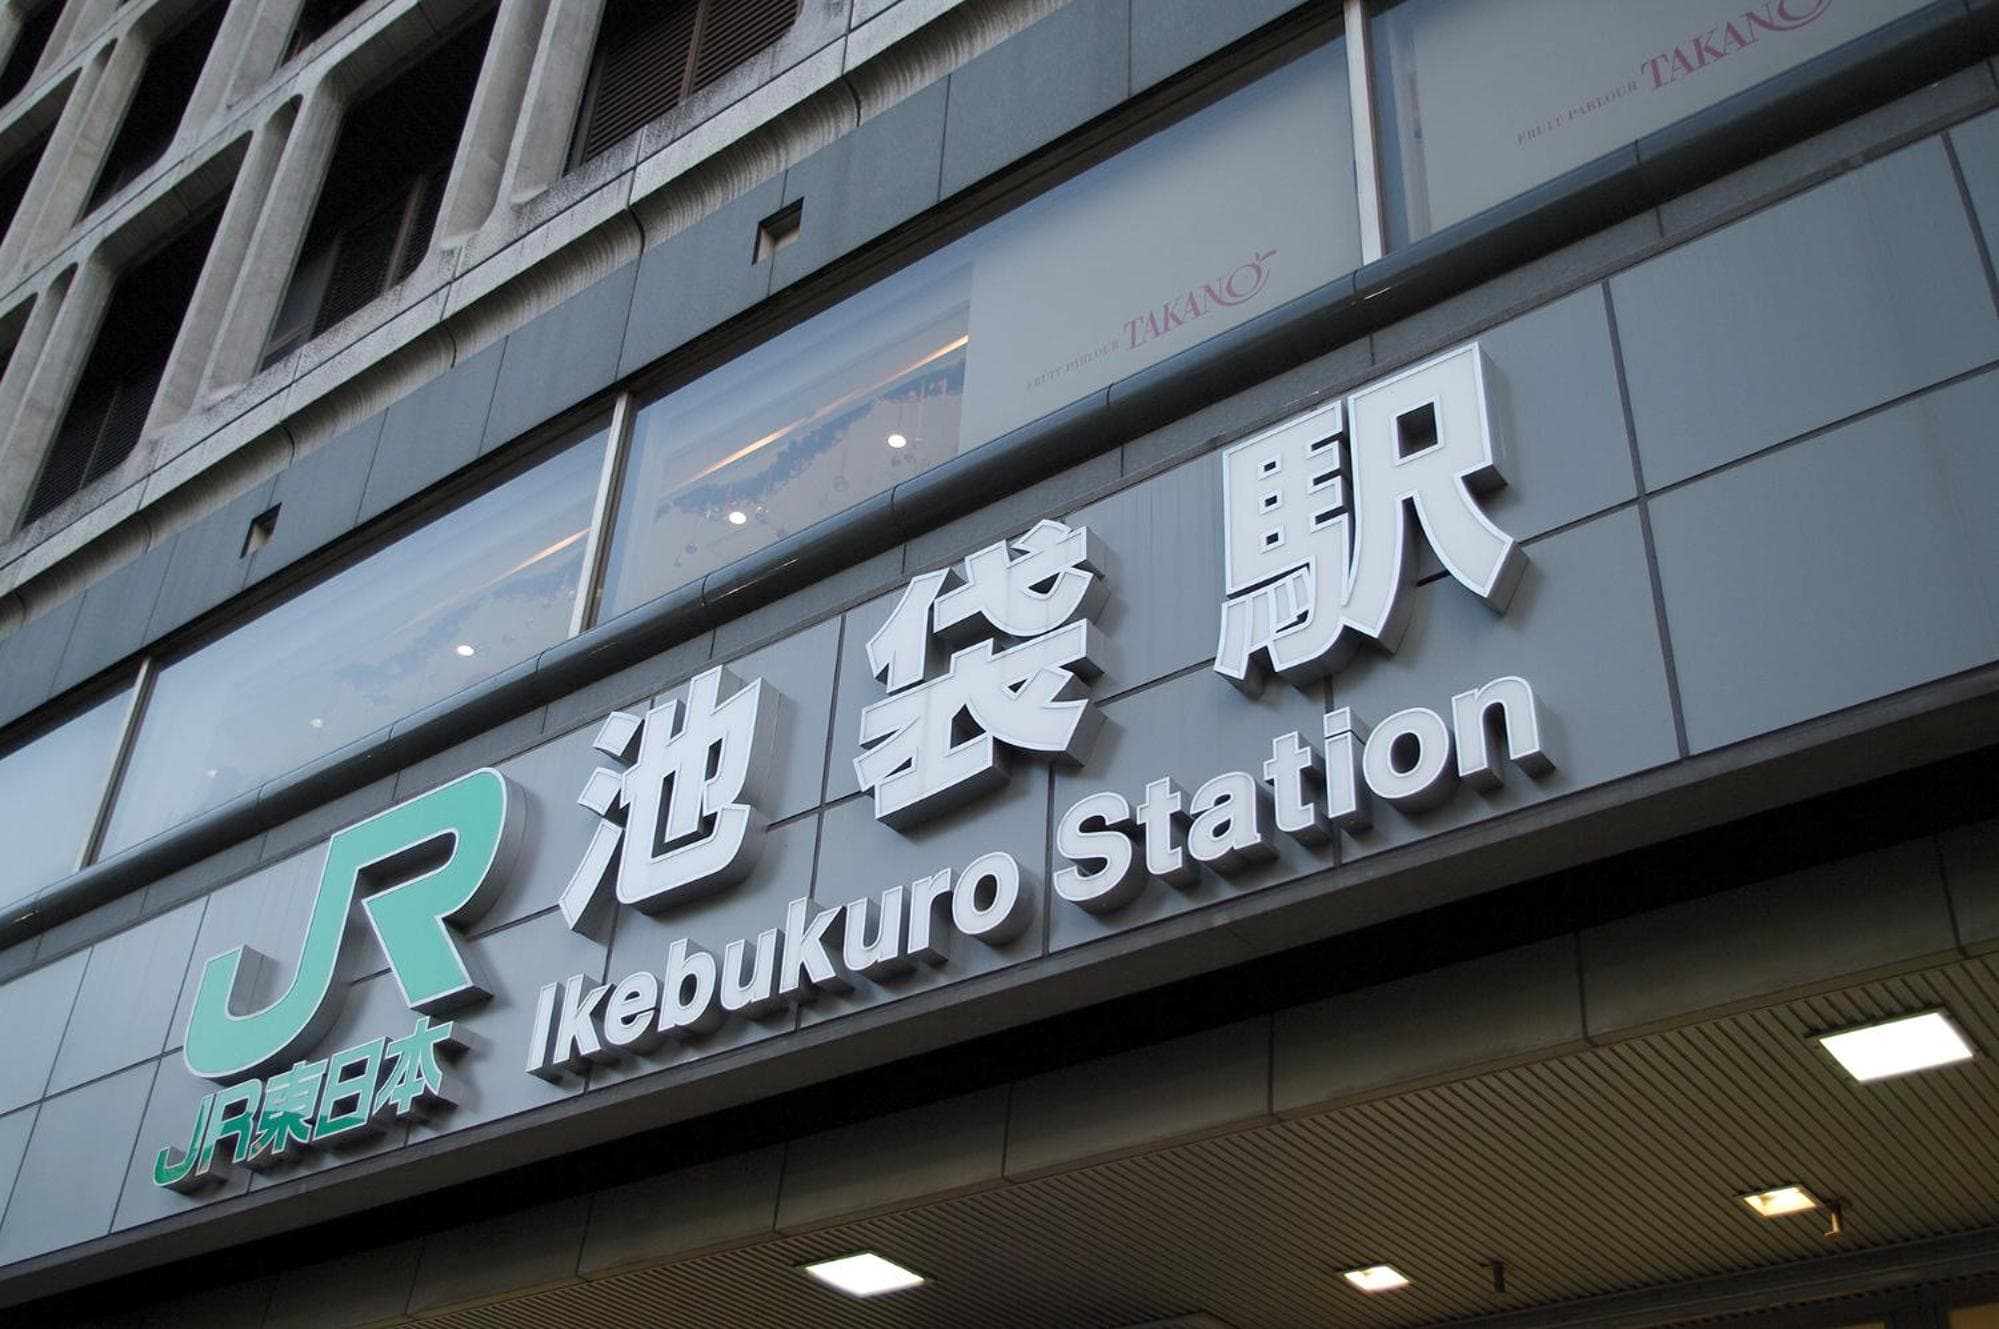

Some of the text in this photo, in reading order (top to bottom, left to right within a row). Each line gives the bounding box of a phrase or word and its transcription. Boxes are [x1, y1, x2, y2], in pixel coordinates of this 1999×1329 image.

[1567, 80, 1638, 121] PARLOUR
[1123, 249, 1278, 350] TAKANO
[559, 341, 1519, 932] 池袋駅
[184, 766, 508, 1078] JR
[526, 675, 1541, 1074] Ikebukuro Station
[152, 1016, 455, 1187] JR東日本
